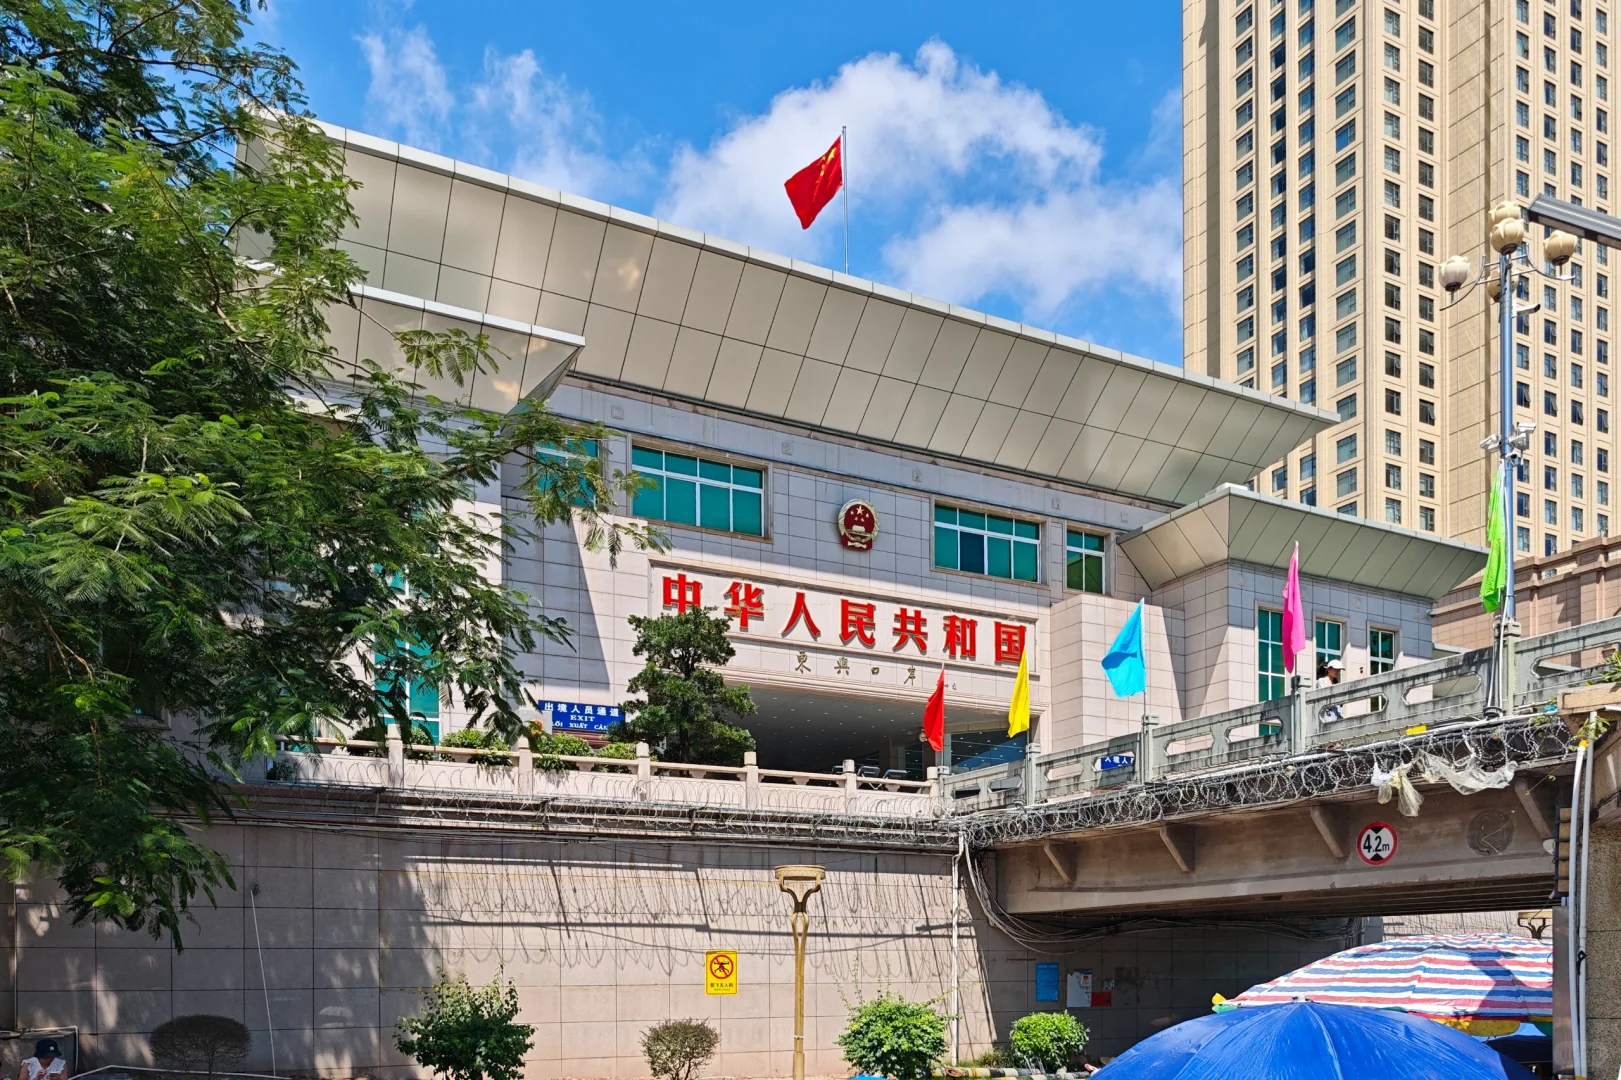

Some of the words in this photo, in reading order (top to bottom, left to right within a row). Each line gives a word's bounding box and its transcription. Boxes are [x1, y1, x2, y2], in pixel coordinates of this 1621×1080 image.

[662, 573, 1027, 663] 中华人民共和国
[544, 702, 619, 717] 出境人员通道
[570, 714, 595, 722] EXIT
[1363, 834, 1390, 853] 4.2m
